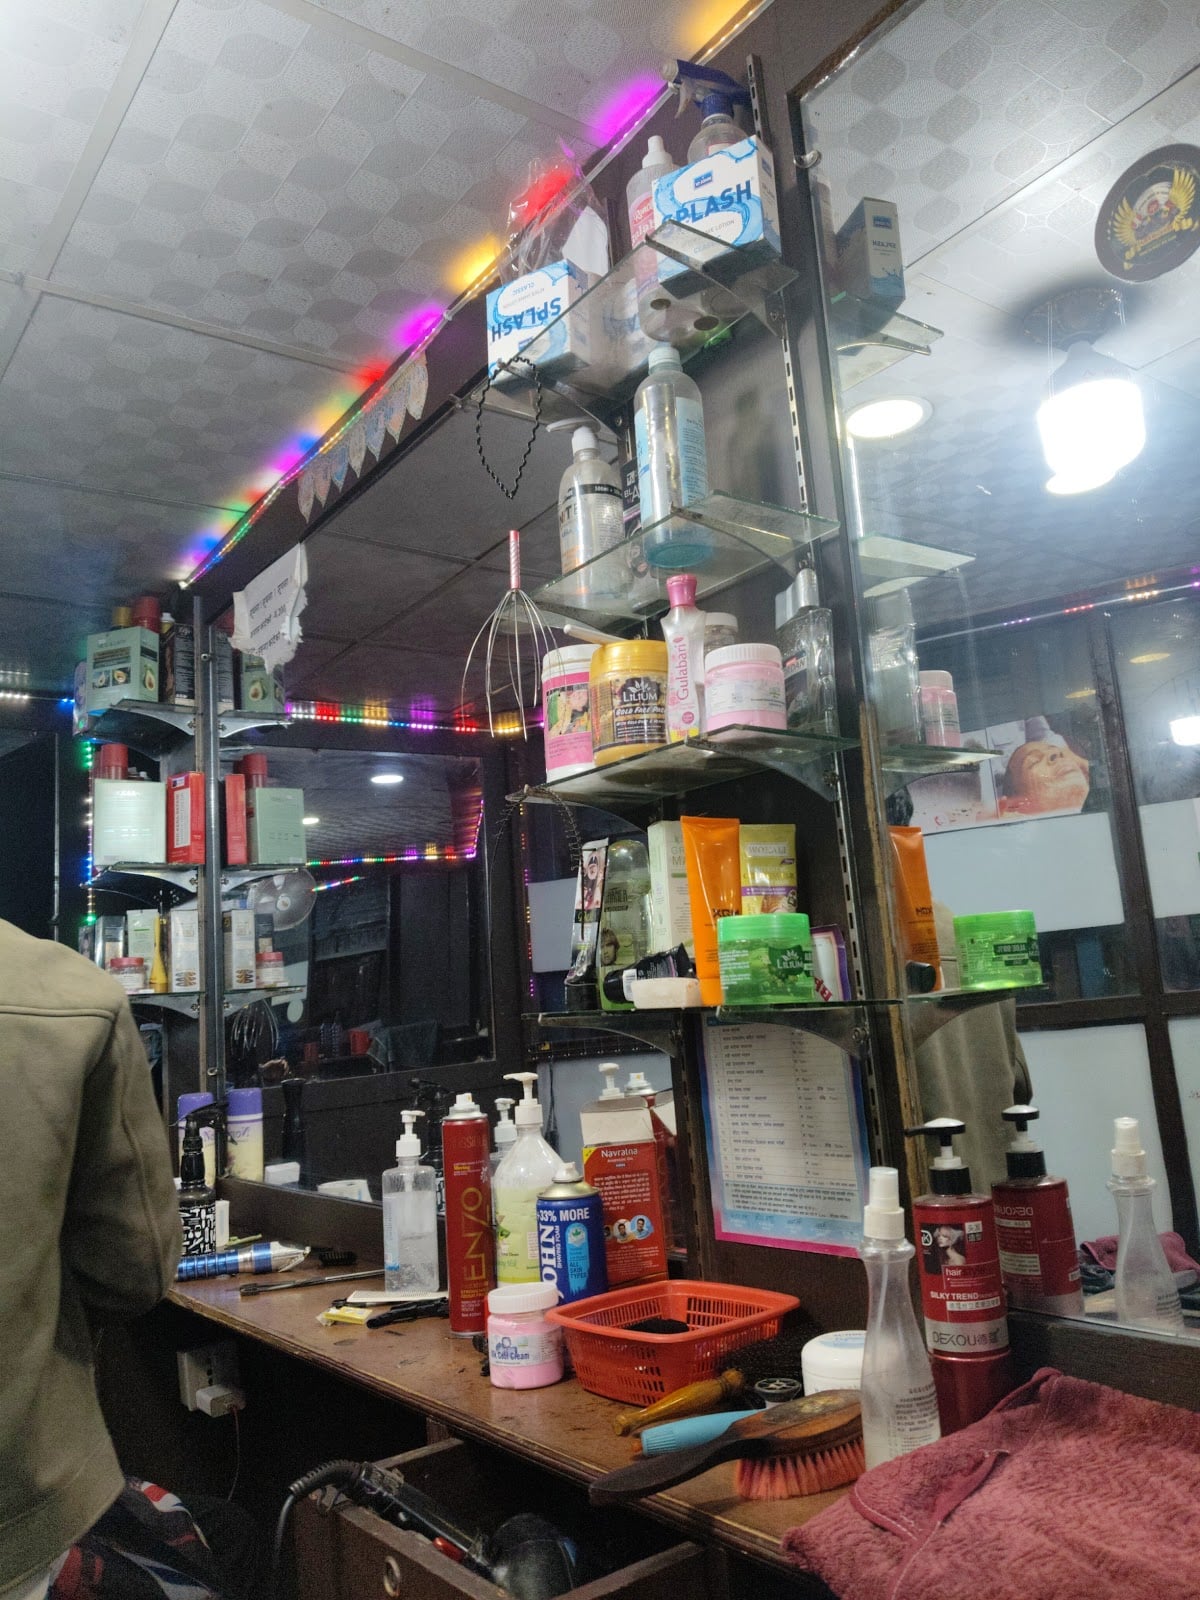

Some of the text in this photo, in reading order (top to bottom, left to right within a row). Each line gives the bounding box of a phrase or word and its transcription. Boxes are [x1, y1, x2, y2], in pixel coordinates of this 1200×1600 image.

[491, 297, 561, 343] SPLASH
[675, 643, 689, 701] Gulabari
[601, 1147, 638, 1158] Navratna
[559, 1207, 590, 1222] MORE
[540, 1223, 561, 1292] OHN
[555, 1244, 563, 1269] SHAVING
[945, 1268, 962, 1276] hair
[930, 1290, 979, 1300] SILKY TREND
